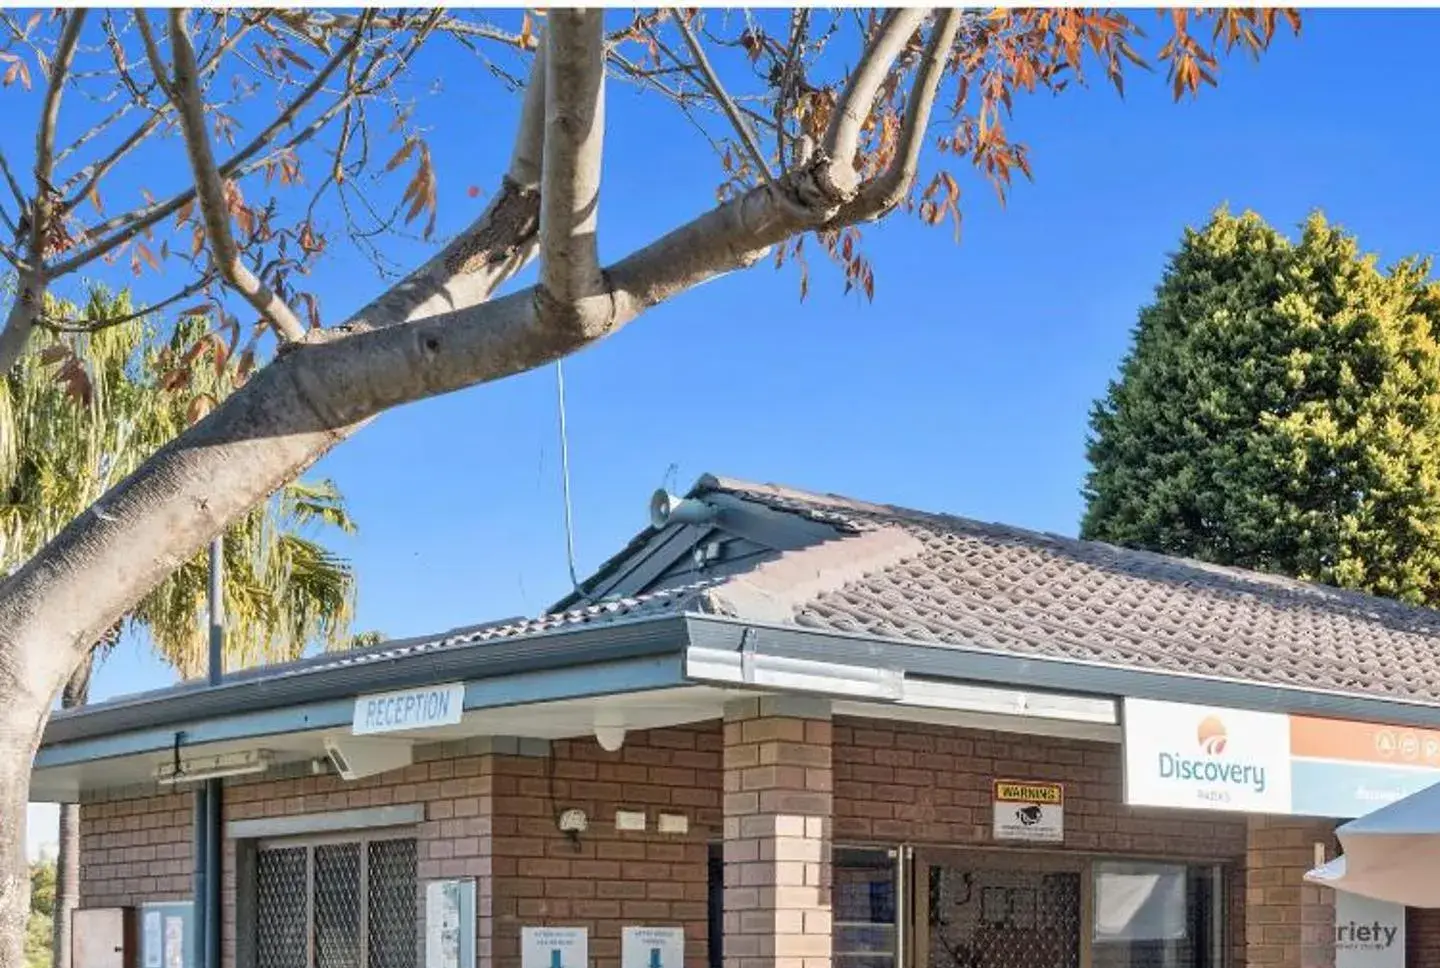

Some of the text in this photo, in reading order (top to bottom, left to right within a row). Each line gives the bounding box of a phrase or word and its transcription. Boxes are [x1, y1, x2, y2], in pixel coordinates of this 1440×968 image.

[365, 690, 451, 728] RECEPTION
[1158, 751, 1267, 793] Discovery
[1002, 784, 1056, 800] WARNING
[1337, 921, 1398, 948] riety
